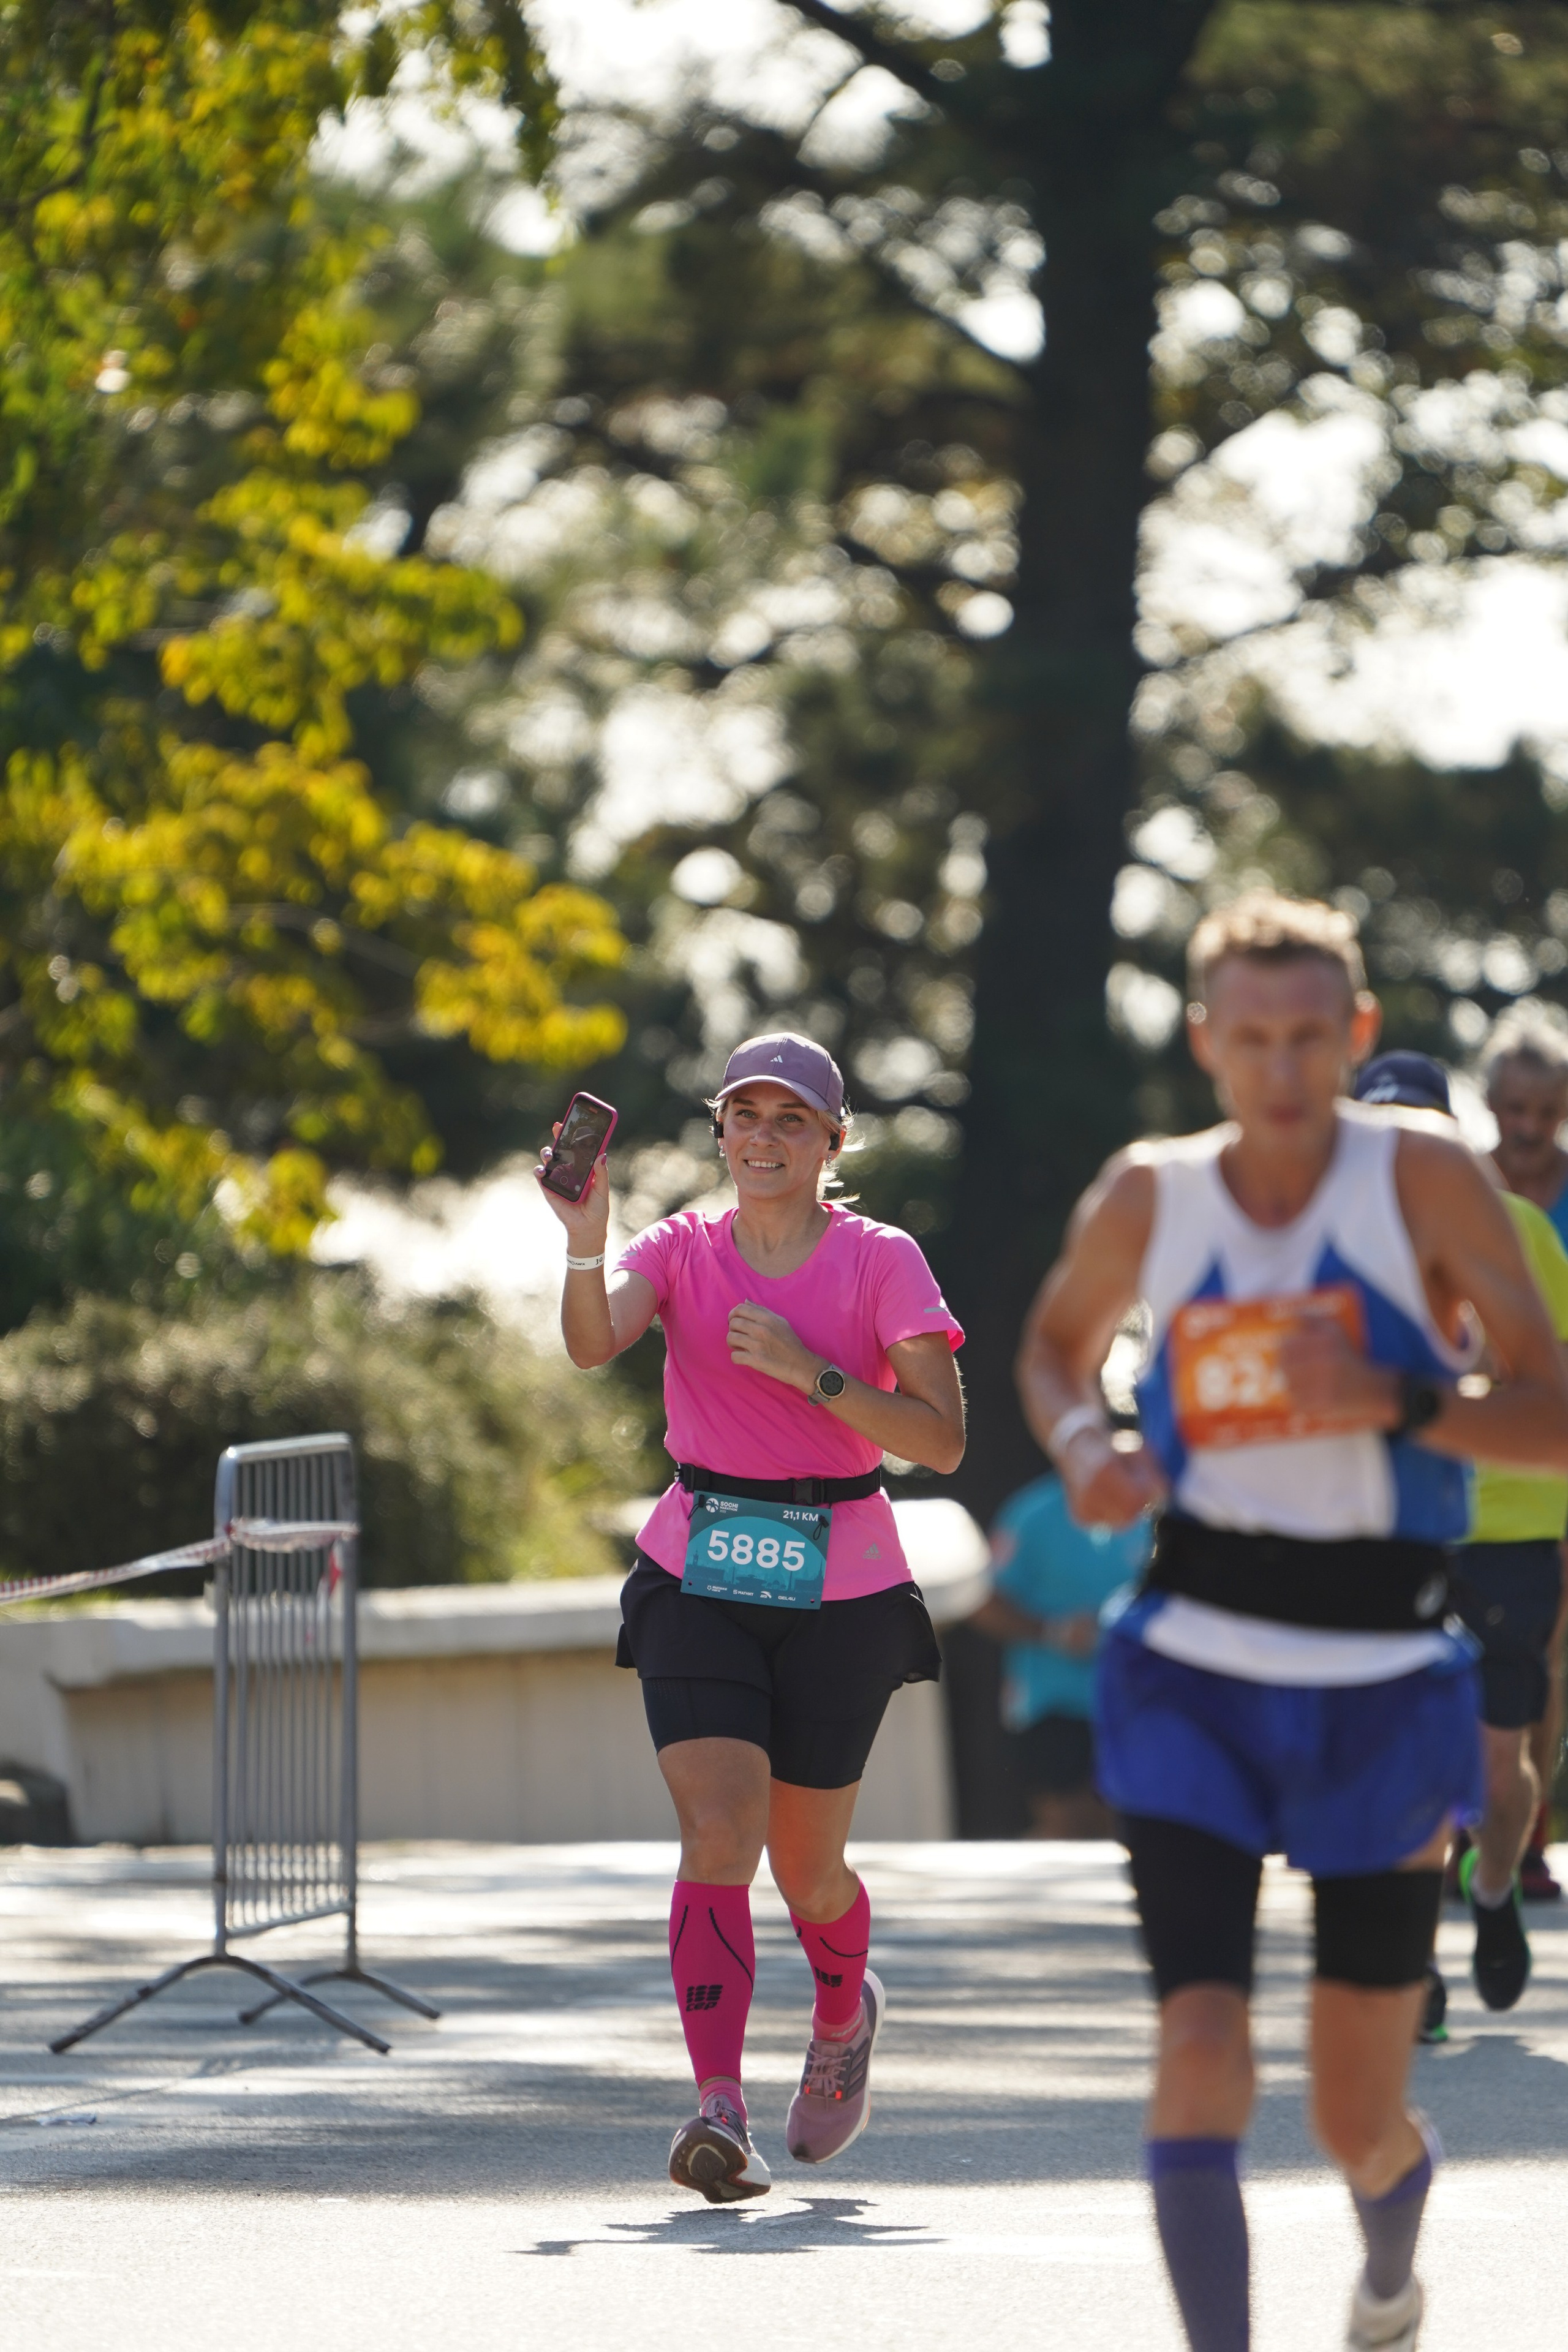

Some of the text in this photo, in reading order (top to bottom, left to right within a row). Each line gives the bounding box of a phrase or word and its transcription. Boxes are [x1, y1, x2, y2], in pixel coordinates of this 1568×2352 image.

[783, 1510, 819, 1522] 21,1 KM
[707, 1530, 805, 1571] 5885
[686, 2002, 717, 2011] cep
